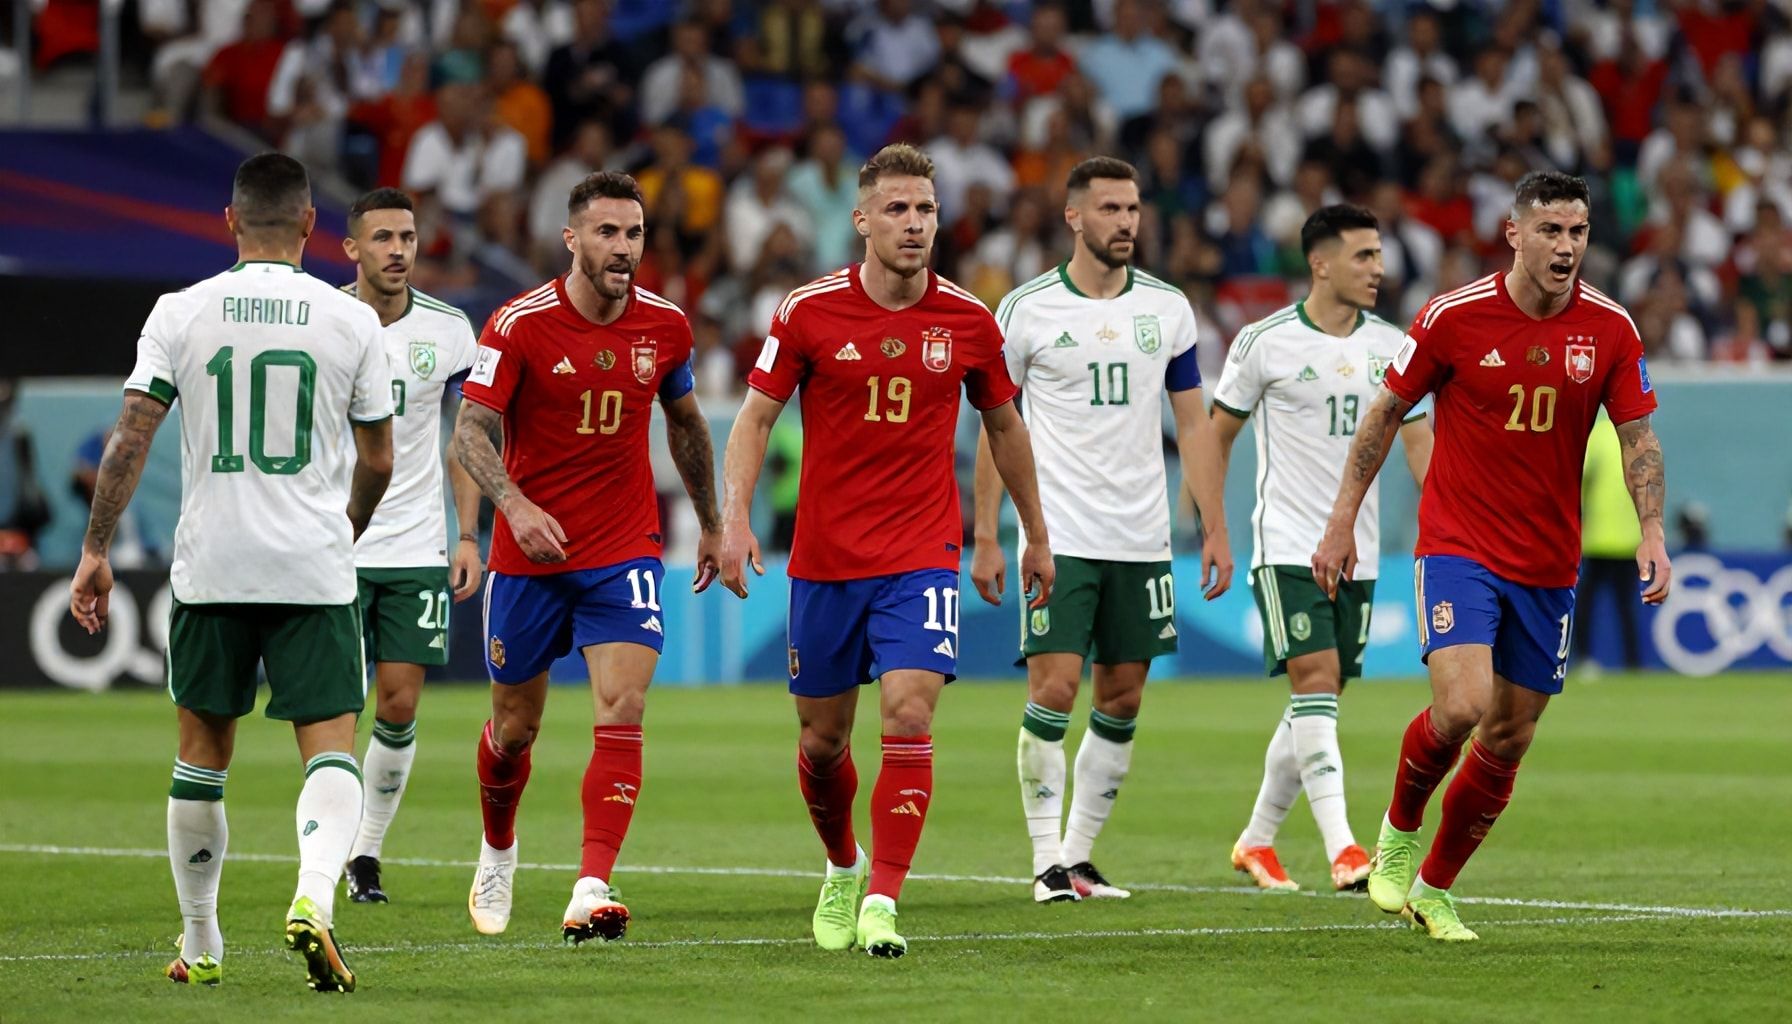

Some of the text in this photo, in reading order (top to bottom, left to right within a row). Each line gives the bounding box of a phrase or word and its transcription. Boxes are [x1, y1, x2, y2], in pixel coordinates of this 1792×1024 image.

[864, 375, 912, 423] 19
[1087, 362, 1129, 406] 10
[205, 345, 317, 475] 10
[576, 389, 623, 435] 10
[1504, 383, 1557, 432] 20
[417, 589, 450, 629] 20
[626, 568, 661, 611] 11
[1145, 573, 1174, 620] 10
